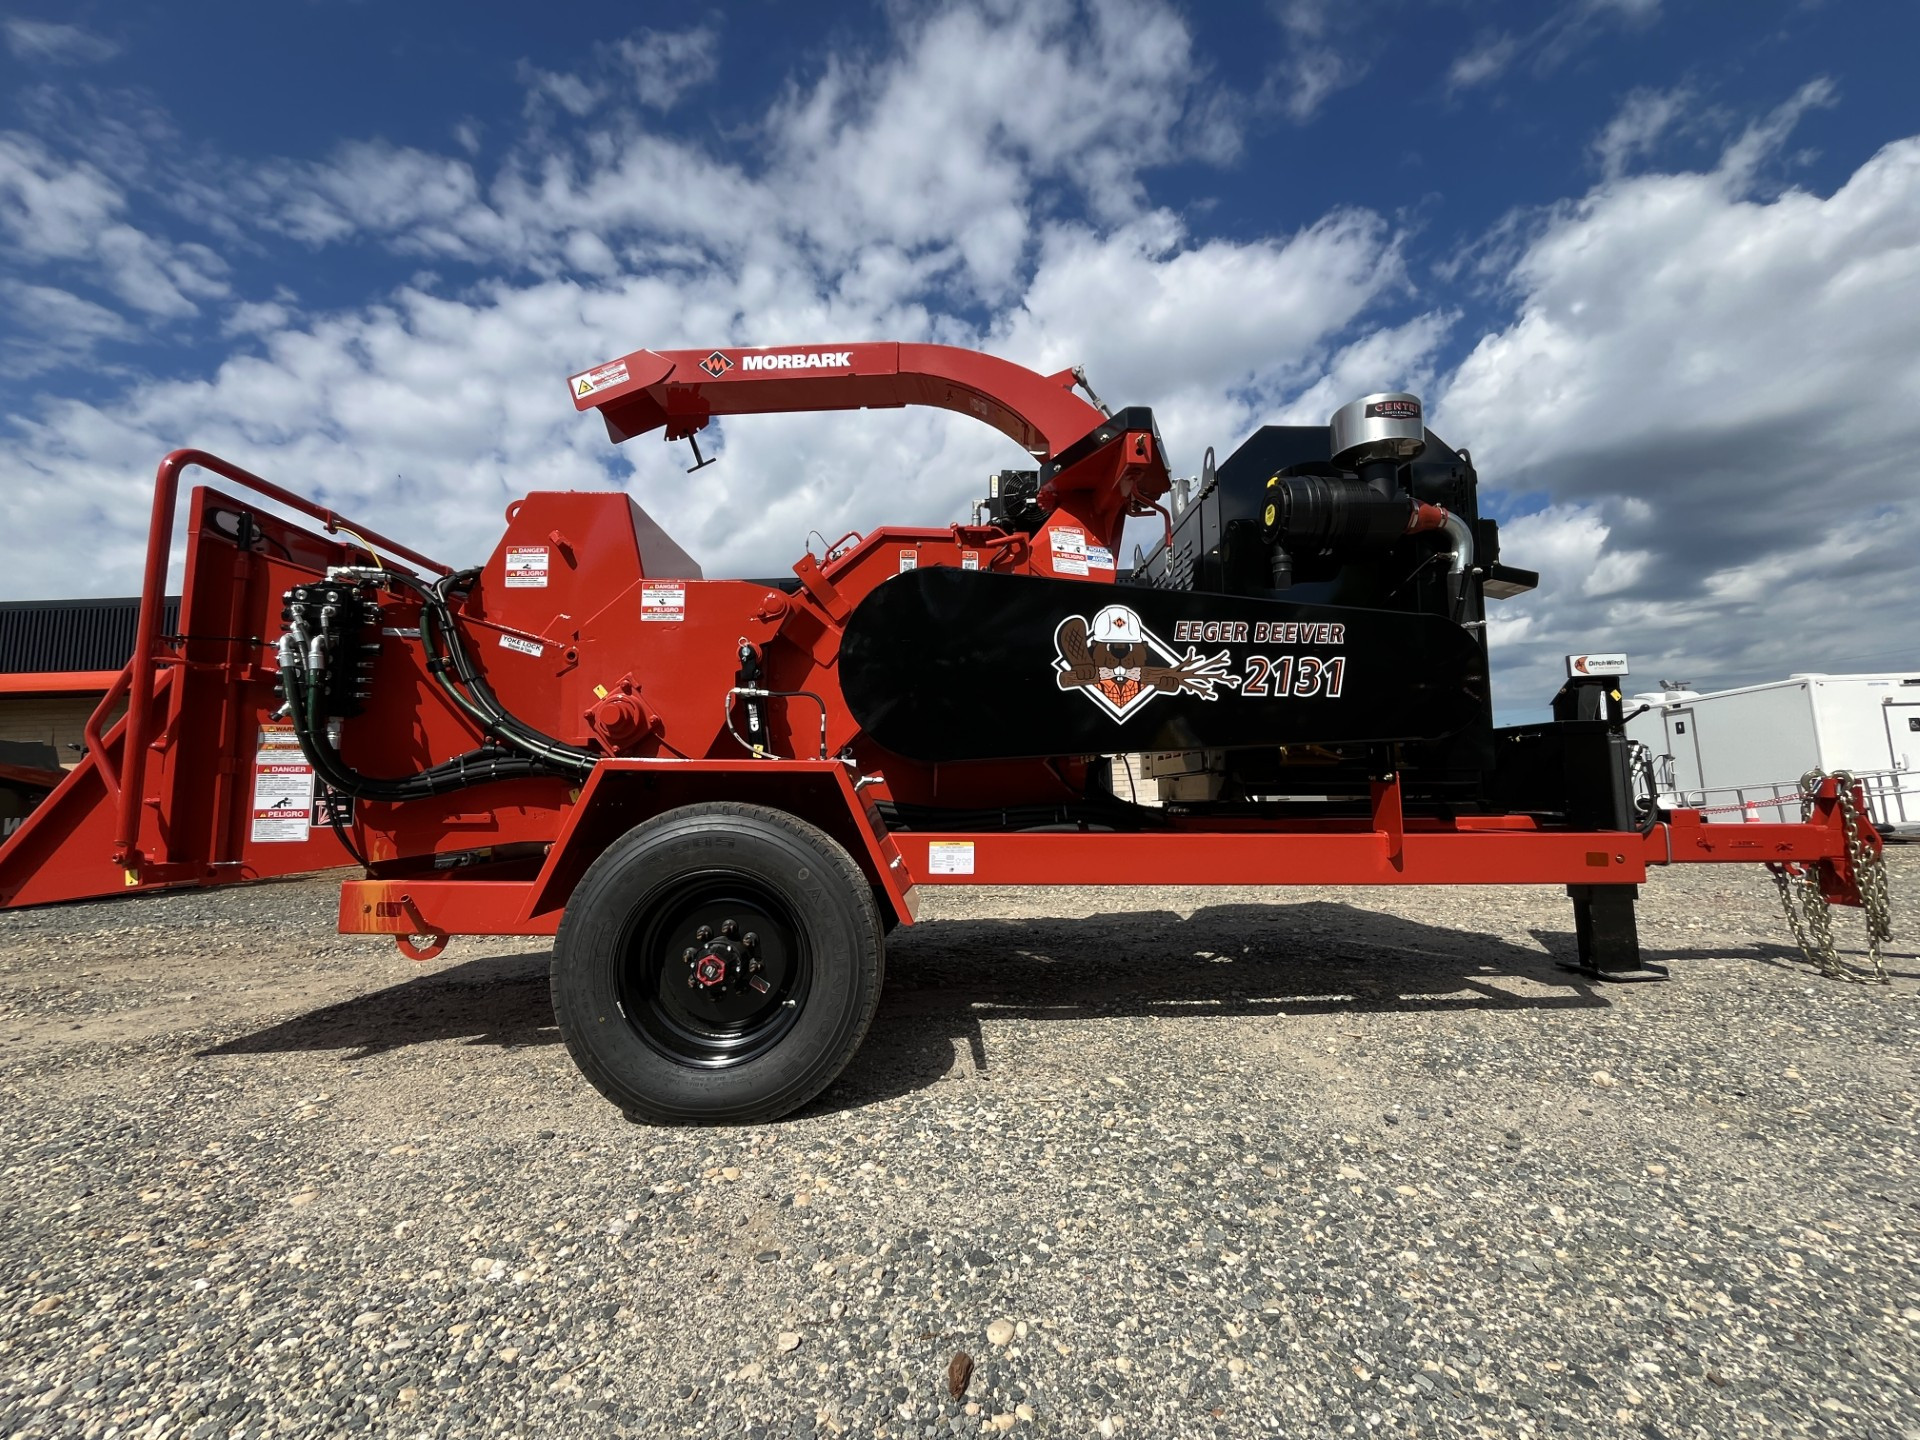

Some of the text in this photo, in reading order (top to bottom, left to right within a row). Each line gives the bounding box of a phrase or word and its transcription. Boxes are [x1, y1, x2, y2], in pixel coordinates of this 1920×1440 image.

[742, 352, 851, 371] MORBARK
[503, 635, 521, 645] YOKE
[522, 641, 541, 651] LOCK
[1174, 621, 1345, 644] EEGER BEEVER
[1241, 655, 1346, 698] 2131
